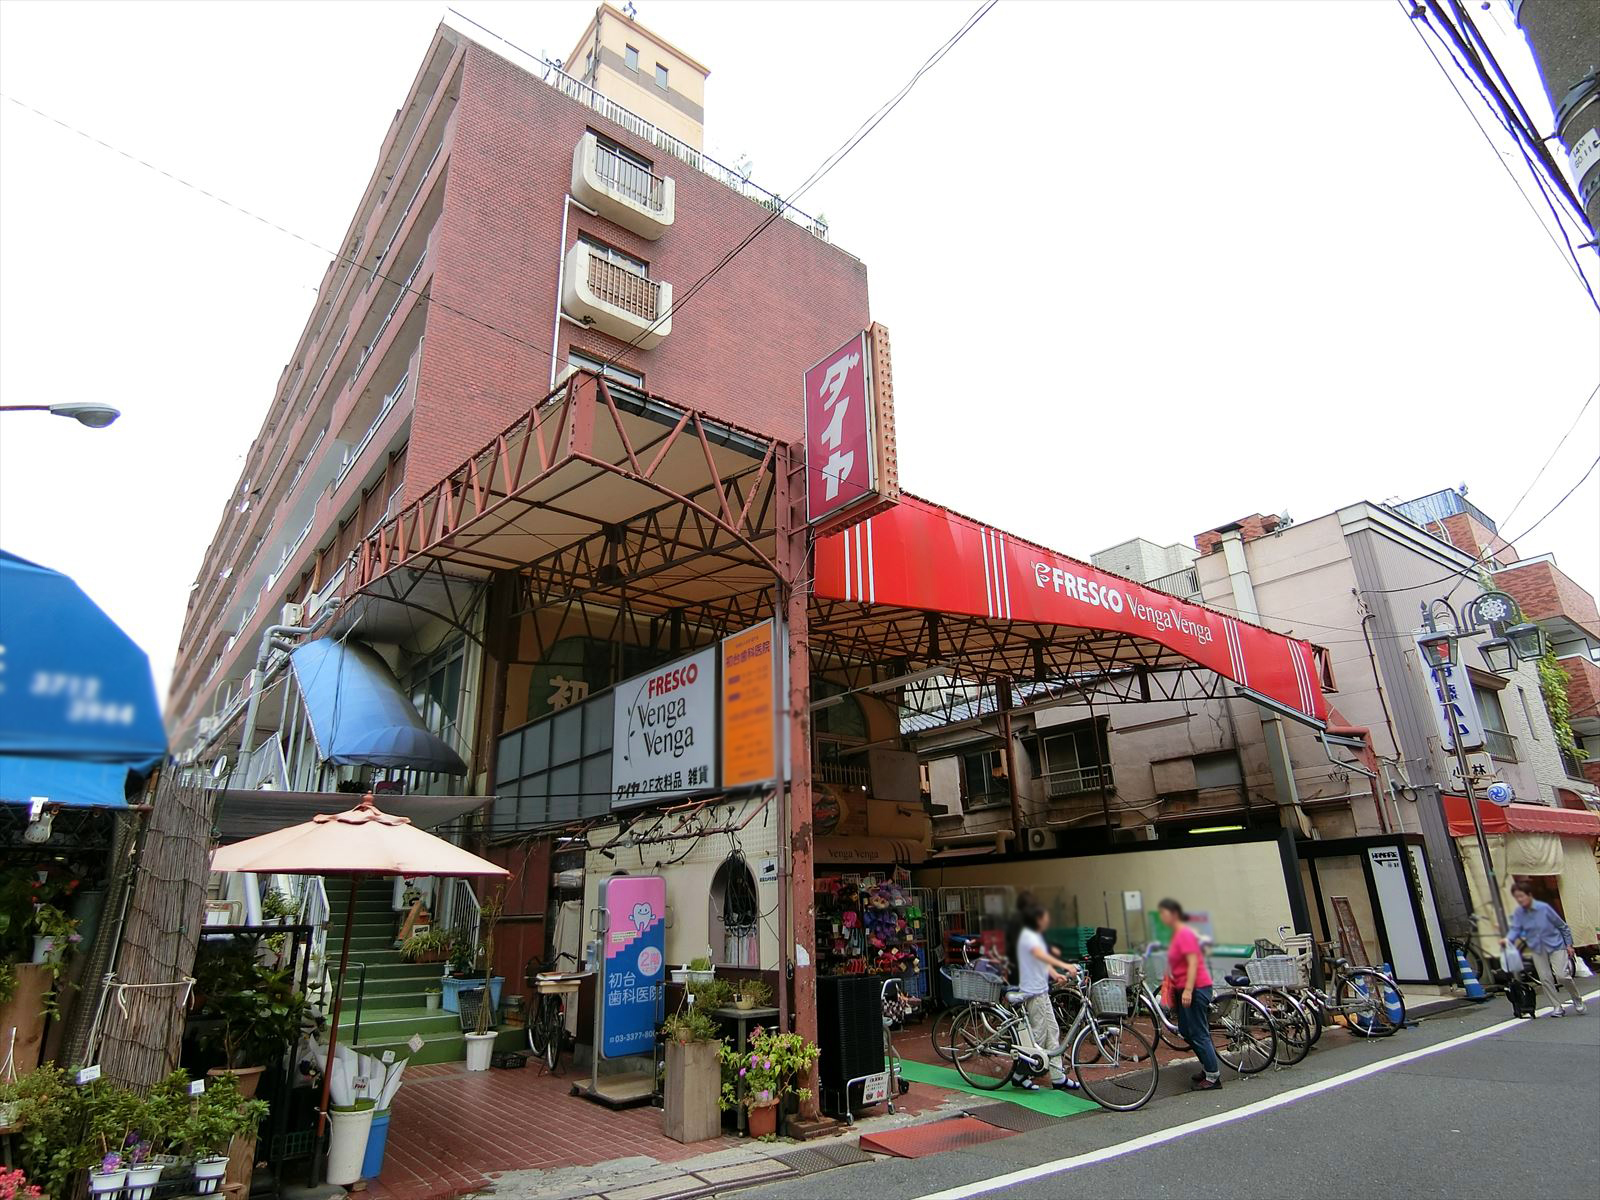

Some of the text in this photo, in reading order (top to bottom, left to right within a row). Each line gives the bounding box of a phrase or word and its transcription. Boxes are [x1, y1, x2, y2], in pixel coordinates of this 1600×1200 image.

[819, 352, 860, 502] ダイヤ
[1052, 567, 1213, 645] FRESCO Venga Venga
[648, 663, 698, 699] FRESCO
[637, 697, 687, 729] Venga
[643, 725, 694, 758] Venga
[616, 781, 641, 800] ダイヤ
[688, 765, 708, 786] 雑貨
[828, 848, 879, 861] Venga Venga
[608, 971, 636, 988] 初台
[608, 985, 662, 1006] 歯科医院
